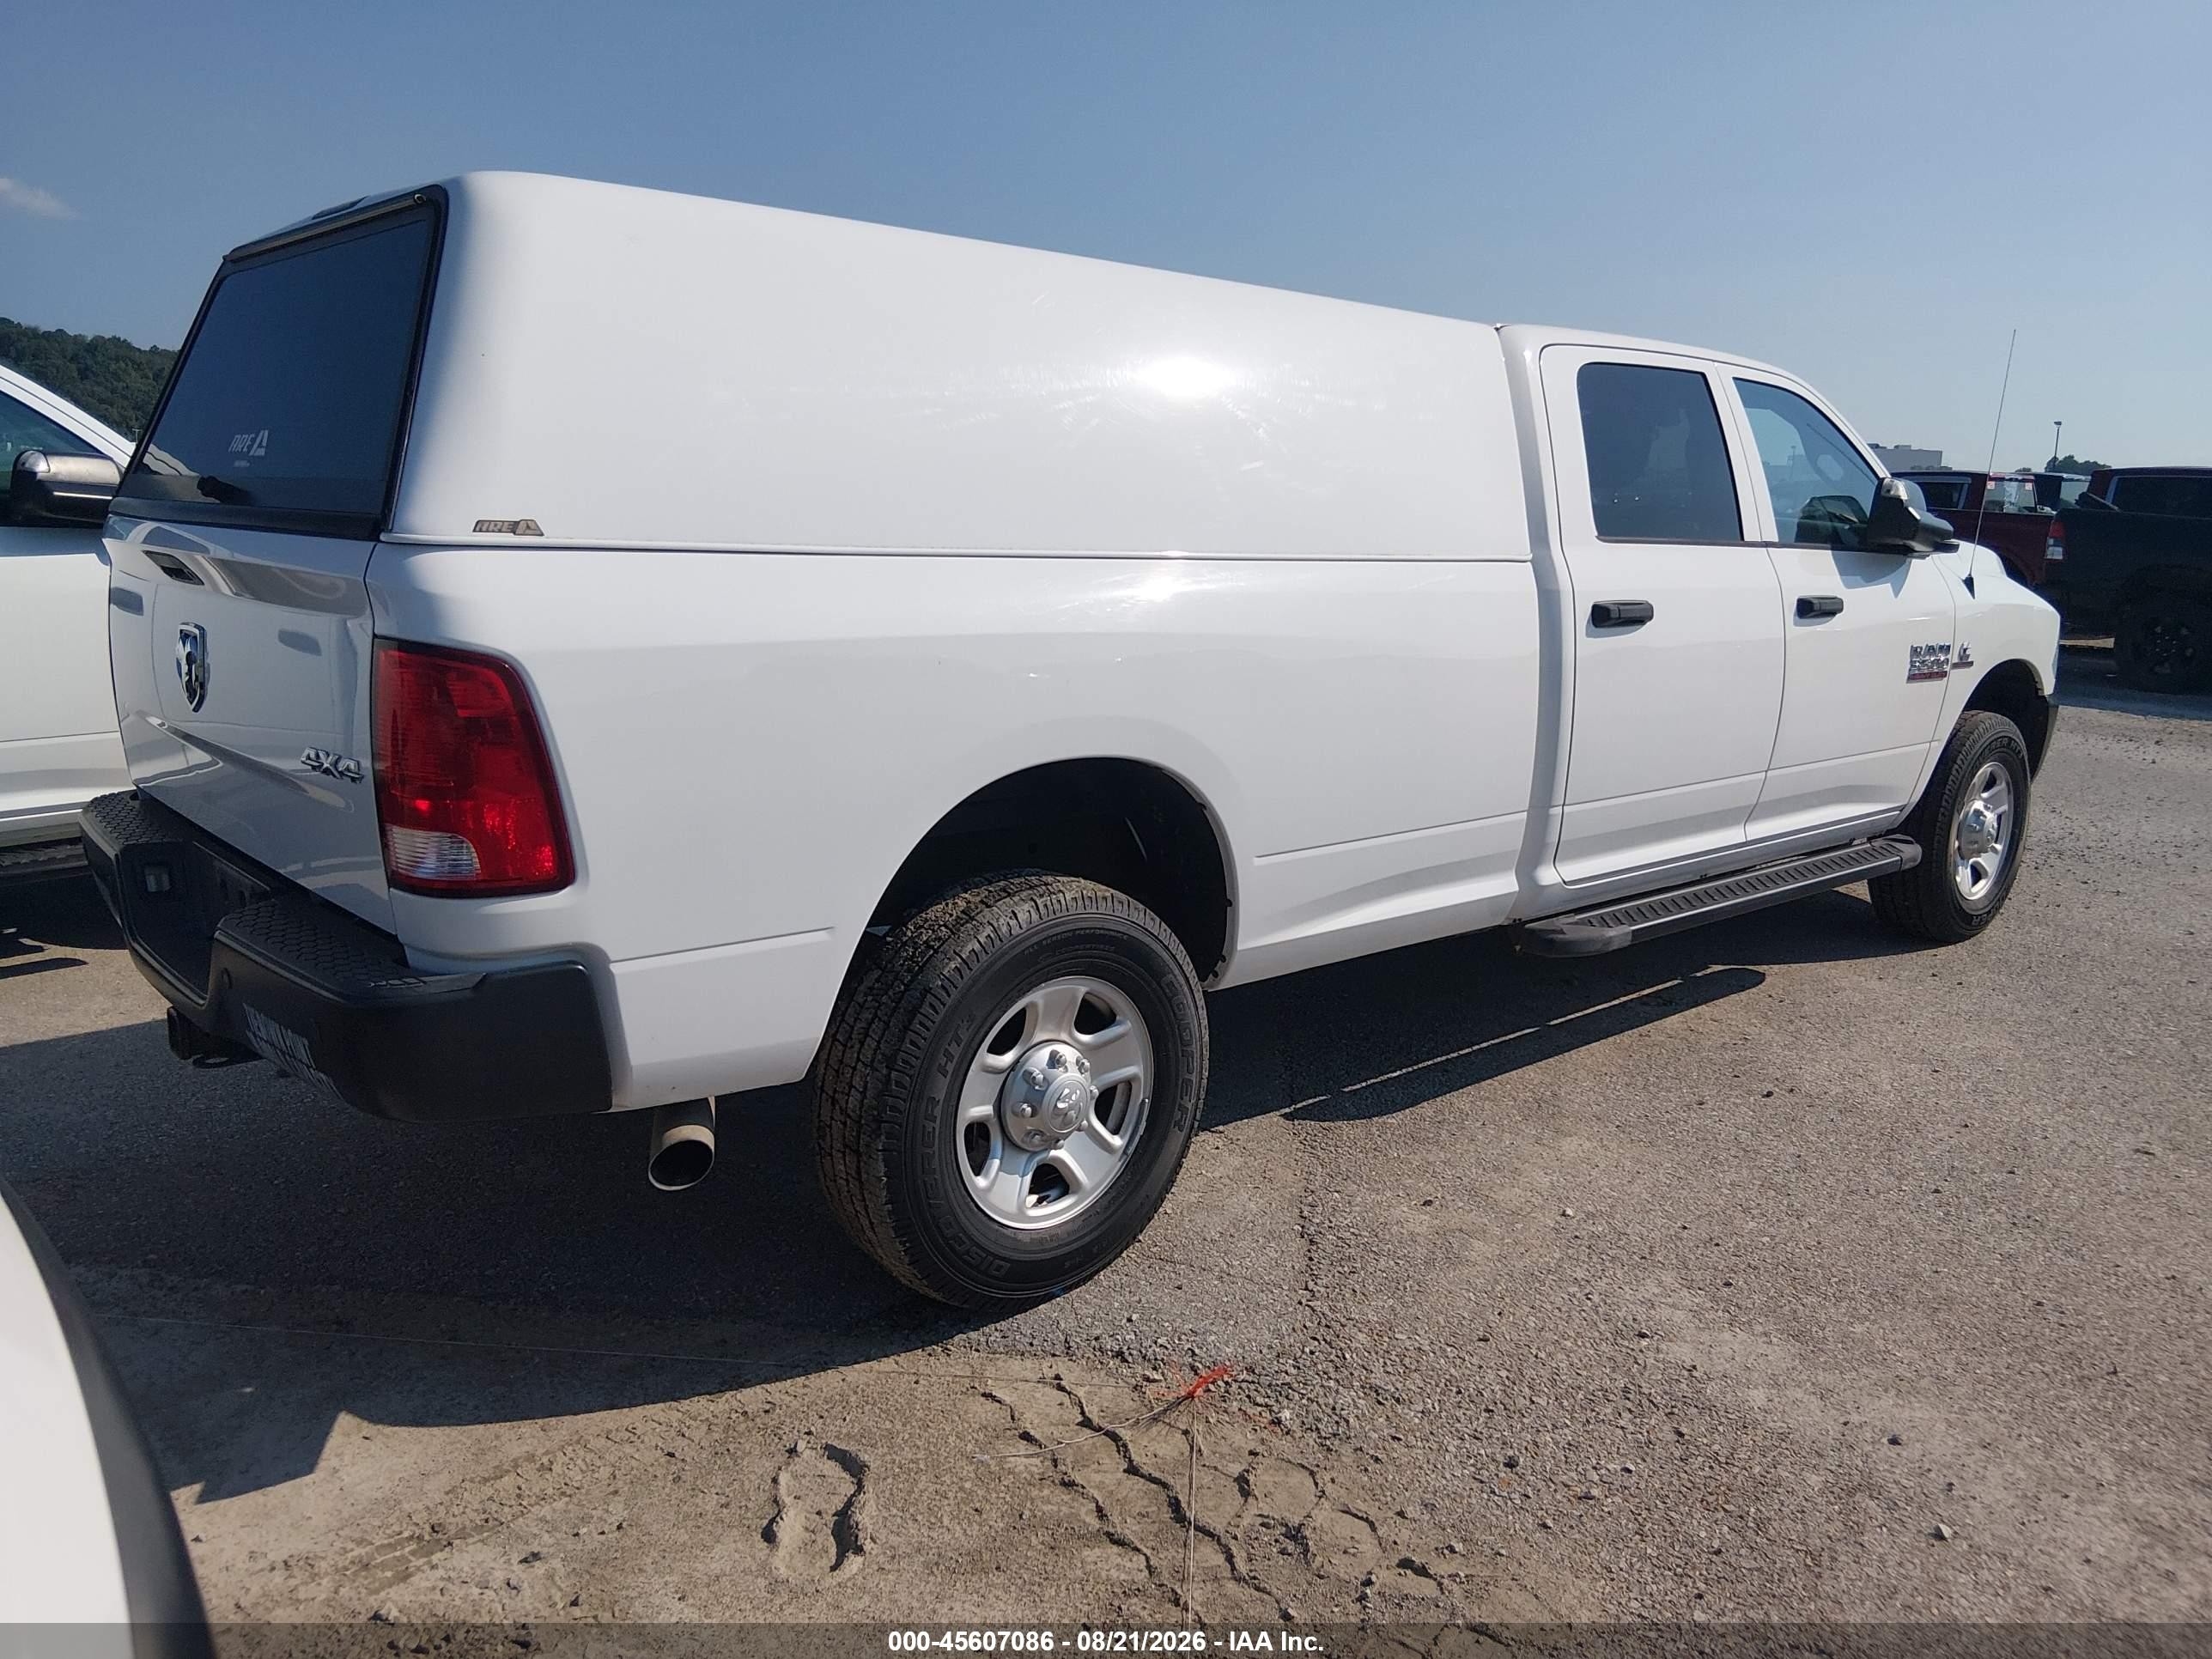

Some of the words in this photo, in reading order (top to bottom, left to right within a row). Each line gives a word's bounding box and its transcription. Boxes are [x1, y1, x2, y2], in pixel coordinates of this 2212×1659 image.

[1909, 642, 1952, 659] RAM
[1161, 974, 1197, 1133] COOPER
[921, 1095, 1011, 1279] DISCOVERER
